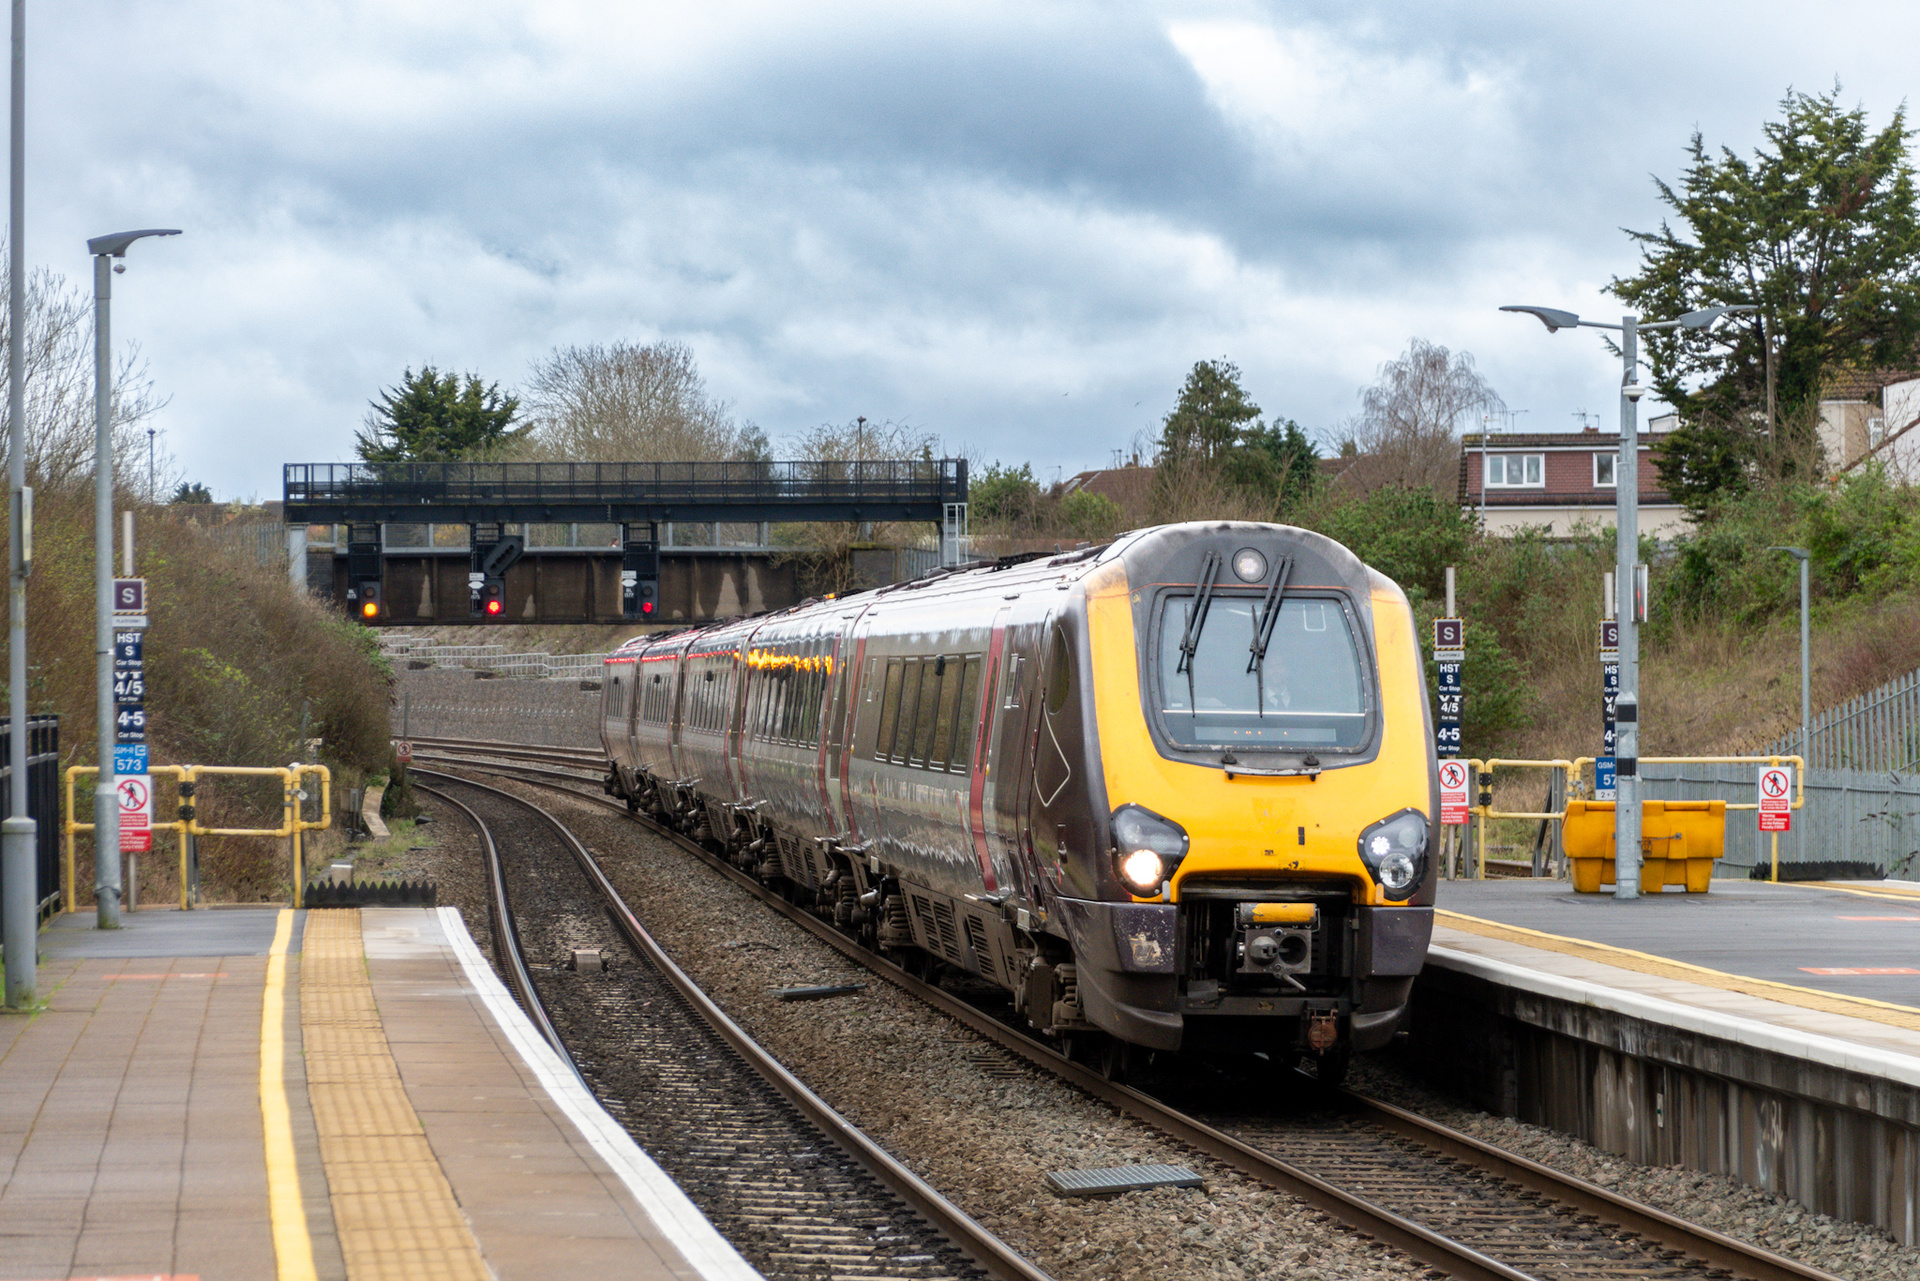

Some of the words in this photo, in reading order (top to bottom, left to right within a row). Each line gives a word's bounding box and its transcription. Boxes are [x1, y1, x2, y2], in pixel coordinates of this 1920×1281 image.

[122, 588, 135, 603] S
[116, 633, 141, 643] HST
[1444, 626, 1454, 640] S
[1608, 628, 1618, 642] S
[125, 646, 134, 656] S
[1440, 664, 1460, 673] HST
[1604, 664, 1619, 674] HS
[1446, 674, 1454, 684] S
[1610, 676, 1617, 685] S
[114, 680, 142, 695] 4/5
[1441, 702, 1459, 713] 4/5
[1606, 704, 1615, 714] 4/
[118, 710, 144, 726] 4-5
[1438, 728, 1460, 740] 4-5
[1604, 730, 1616, 742] 4-
[117, 758, 142, 771] 573
[1603, 774, 1616, 785] 57
